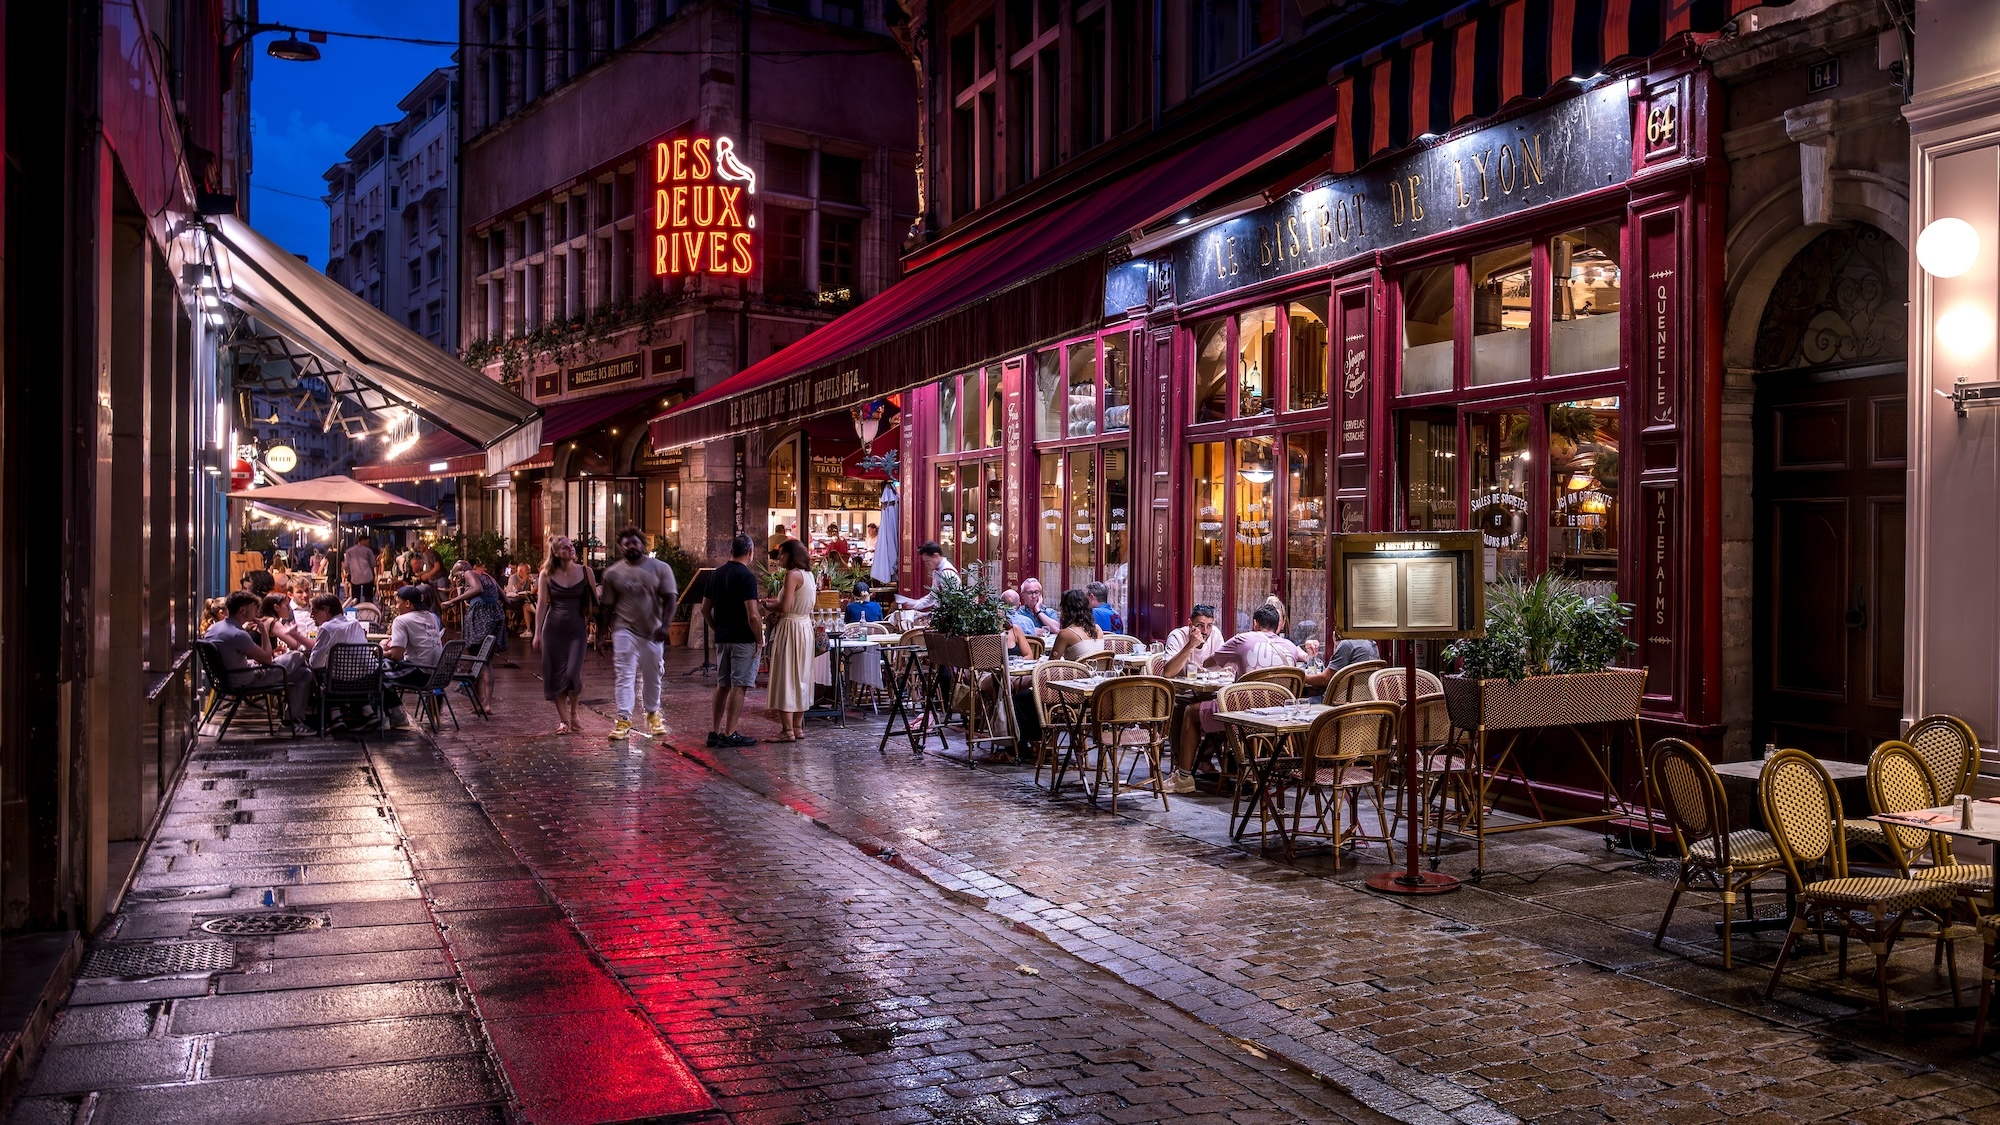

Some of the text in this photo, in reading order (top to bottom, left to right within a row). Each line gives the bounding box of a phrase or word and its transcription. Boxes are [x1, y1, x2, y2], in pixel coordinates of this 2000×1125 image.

[1814, 64, 1831, 87] 64
[1647, 102, 1676, 142] 64
[656, 138, 710, 183] DES
[656, 186, 742, 230] DEUX
[1215, 133, 1544, 279] LE BISTROT DE LYON
[656, 231, 752, 275] RIVES
[1159, 268, 1170, 292] 64
[1657, 285, 1667, 405] QUENELLE
[575, 360, 634, 384] BRASSERIE DES DEUX RIVES
[730, 402, 739, 426] LE
[741, 390, 773, 424] BISTROT
[774, 386, 786, 416] DE
[789, 378, 811, 412] LYON
[814, 374, 840, 405] DEPUIS
[1343, 419, 1365, 430] CERVELAS
[1471, 494, 1492, 512] SALLES
[1492, 493, 1500, 504] DE
[1557, 490, 1613, 510] ICI ON CONSULTE
[1494, 514, 1502, 526] ET
[1568, 514, 1600, 526] LE BOTTIN
[1484, 533, 1500, 548] ALONS
[1501, 533, 1509, 547] AU
[1656, 491, 1666, 624] MATEFAIMS
